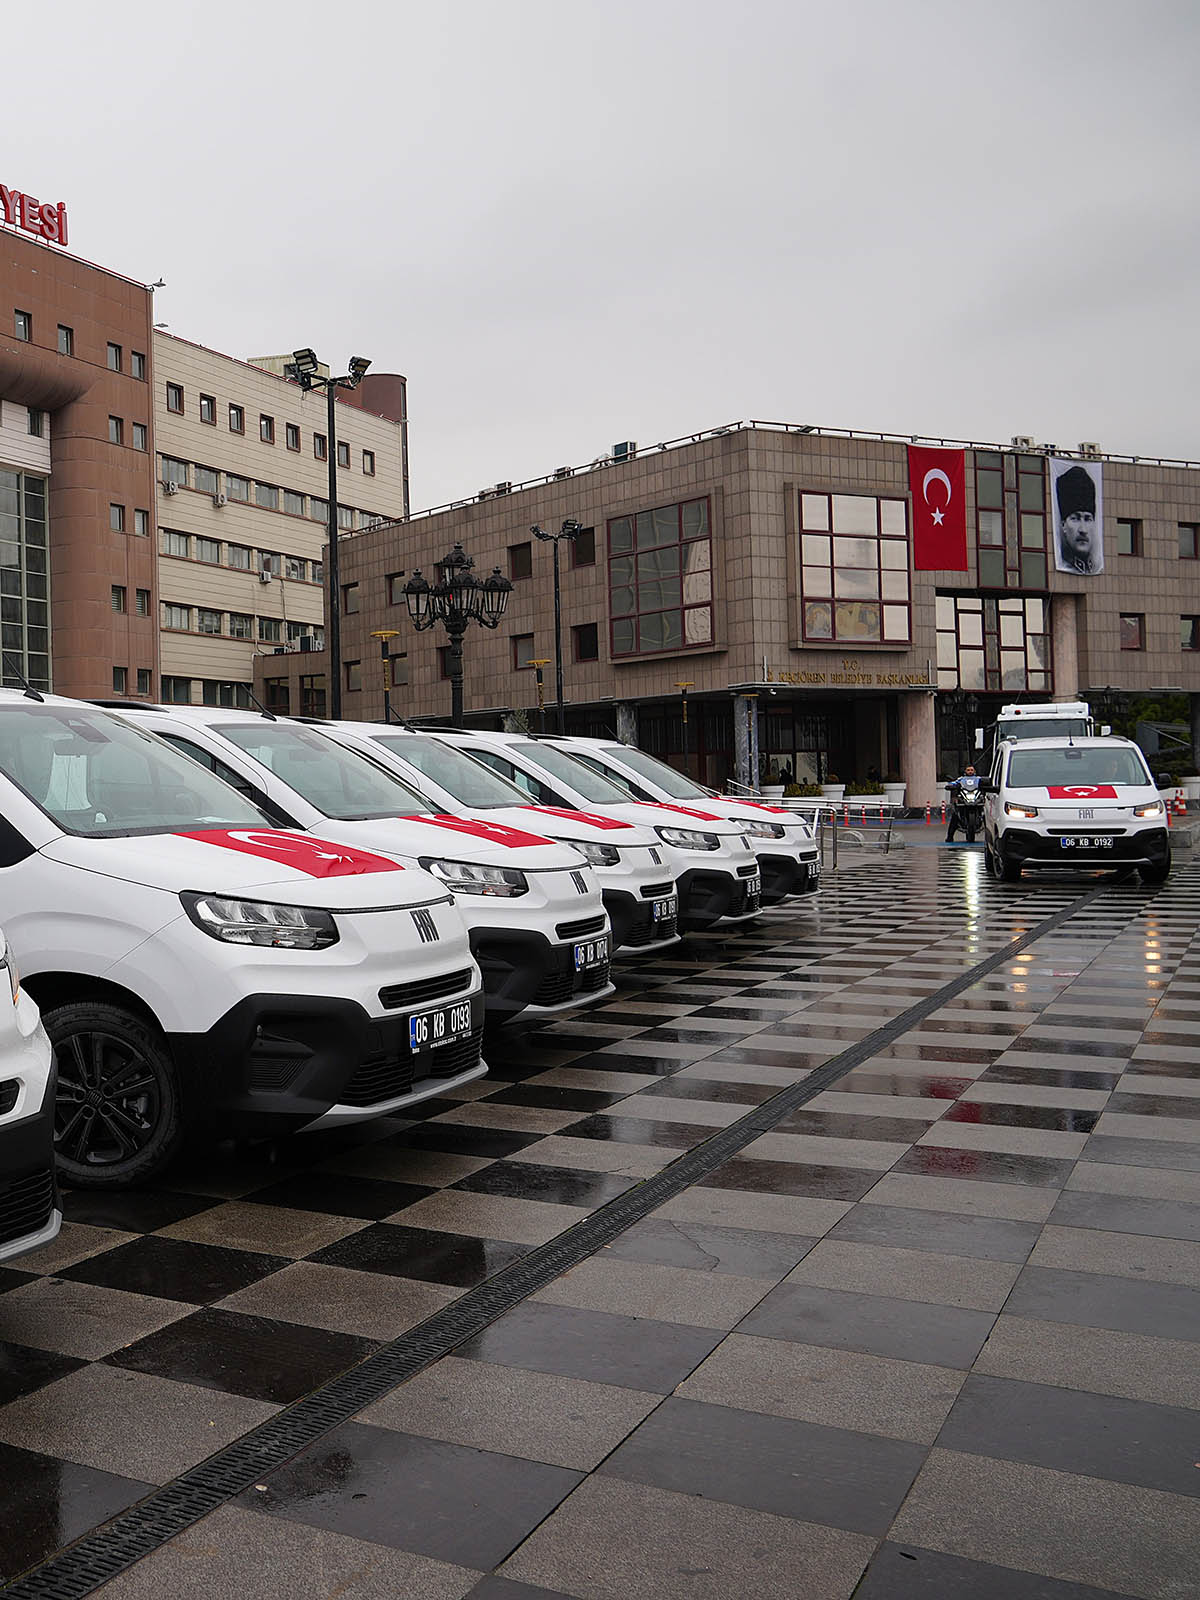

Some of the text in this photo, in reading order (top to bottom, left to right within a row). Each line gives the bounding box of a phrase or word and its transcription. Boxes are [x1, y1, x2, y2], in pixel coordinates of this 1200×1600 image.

[416, 1017, 428, 1043] 06
[433, 1012, 445, 1039] KB
[451, 1004, 470, 1033] 0193
